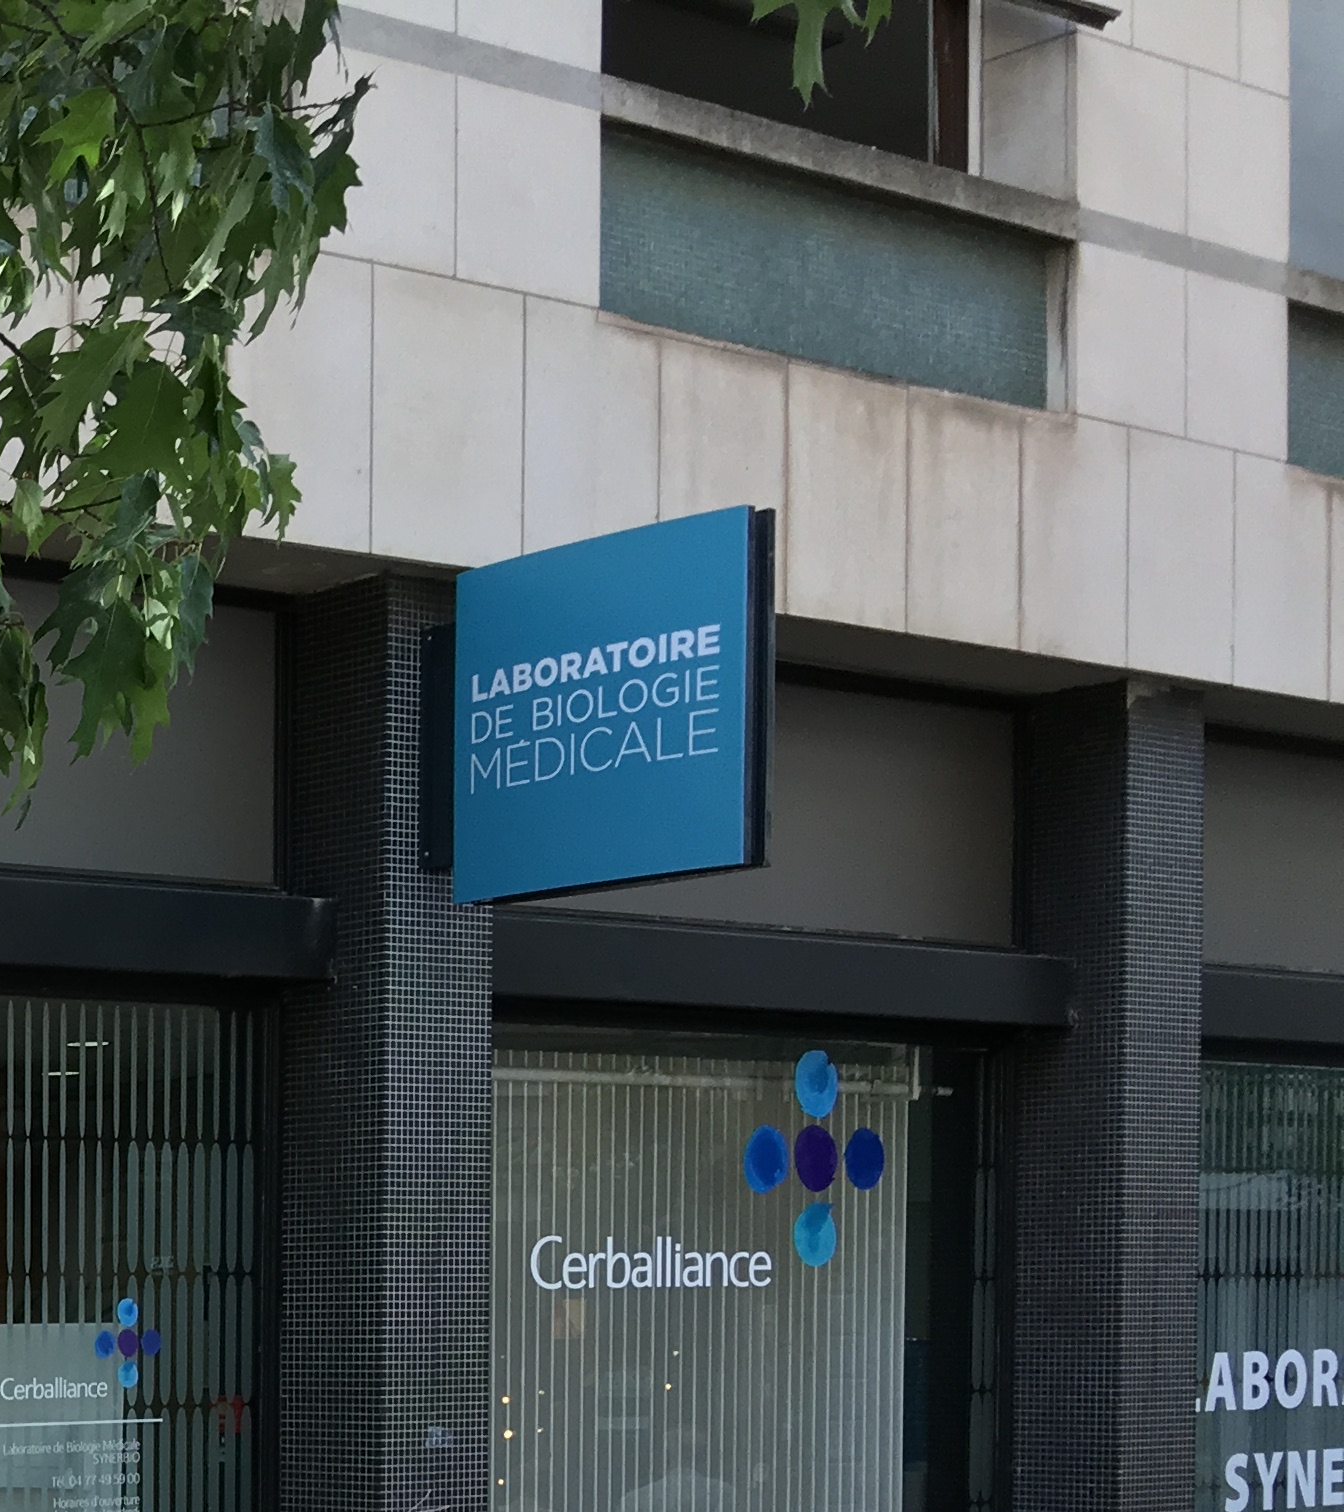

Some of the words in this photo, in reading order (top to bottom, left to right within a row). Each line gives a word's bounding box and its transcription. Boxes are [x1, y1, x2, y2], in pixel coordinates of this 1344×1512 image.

[471, 623, 721, 703] LABORATOIRE
[471, 703, 514, 745] DE
[532, 664, 720, 731] BIOLOGIE
[470, 707, 719, 795] MÉDICALE
[529, 1234, 772, 1291] Cerballiance
[0, 1376, 108, 1401] Cerballiance
[1195, 1349, 1344, 1412] ABOR
[3, 1443, 51, 1456] Laboratoire
[53, 1441, 64, 1454] de
[66, 1440, 100, 1455] Biologie
[85, 1474, 97, 1487] 77
[127, 1472, 140, 1485] 00
[1224, 1448, 1344, 1512] SYNE
